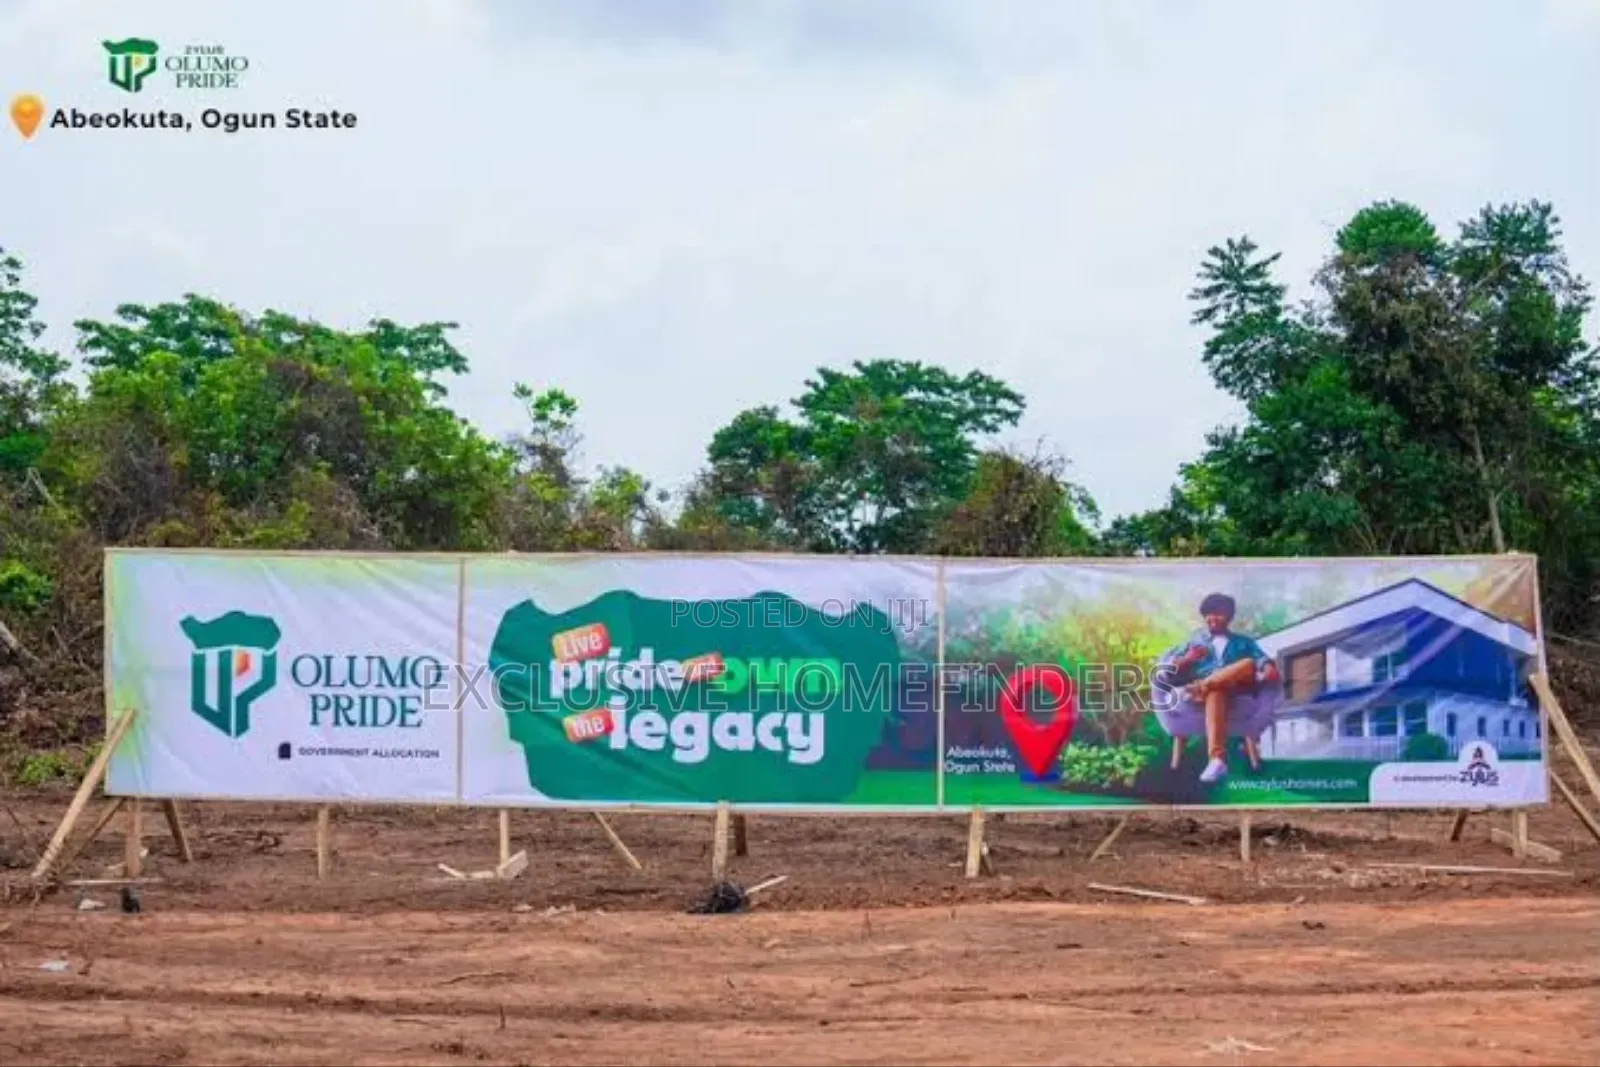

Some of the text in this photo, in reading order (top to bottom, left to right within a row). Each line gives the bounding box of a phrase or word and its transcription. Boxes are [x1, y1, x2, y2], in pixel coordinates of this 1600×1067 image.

[561, 632, 603, 662] Live
[292, 654, 443, 688] OLUMO
[550, 647, 687, 699] pride
[309, 694, 424, 728] PRIDE
[609, 696, 825, 764] legacy
[372, 748, 440, 759] ALLOCATION
[944, 760, 1015, 775] Ogun State
